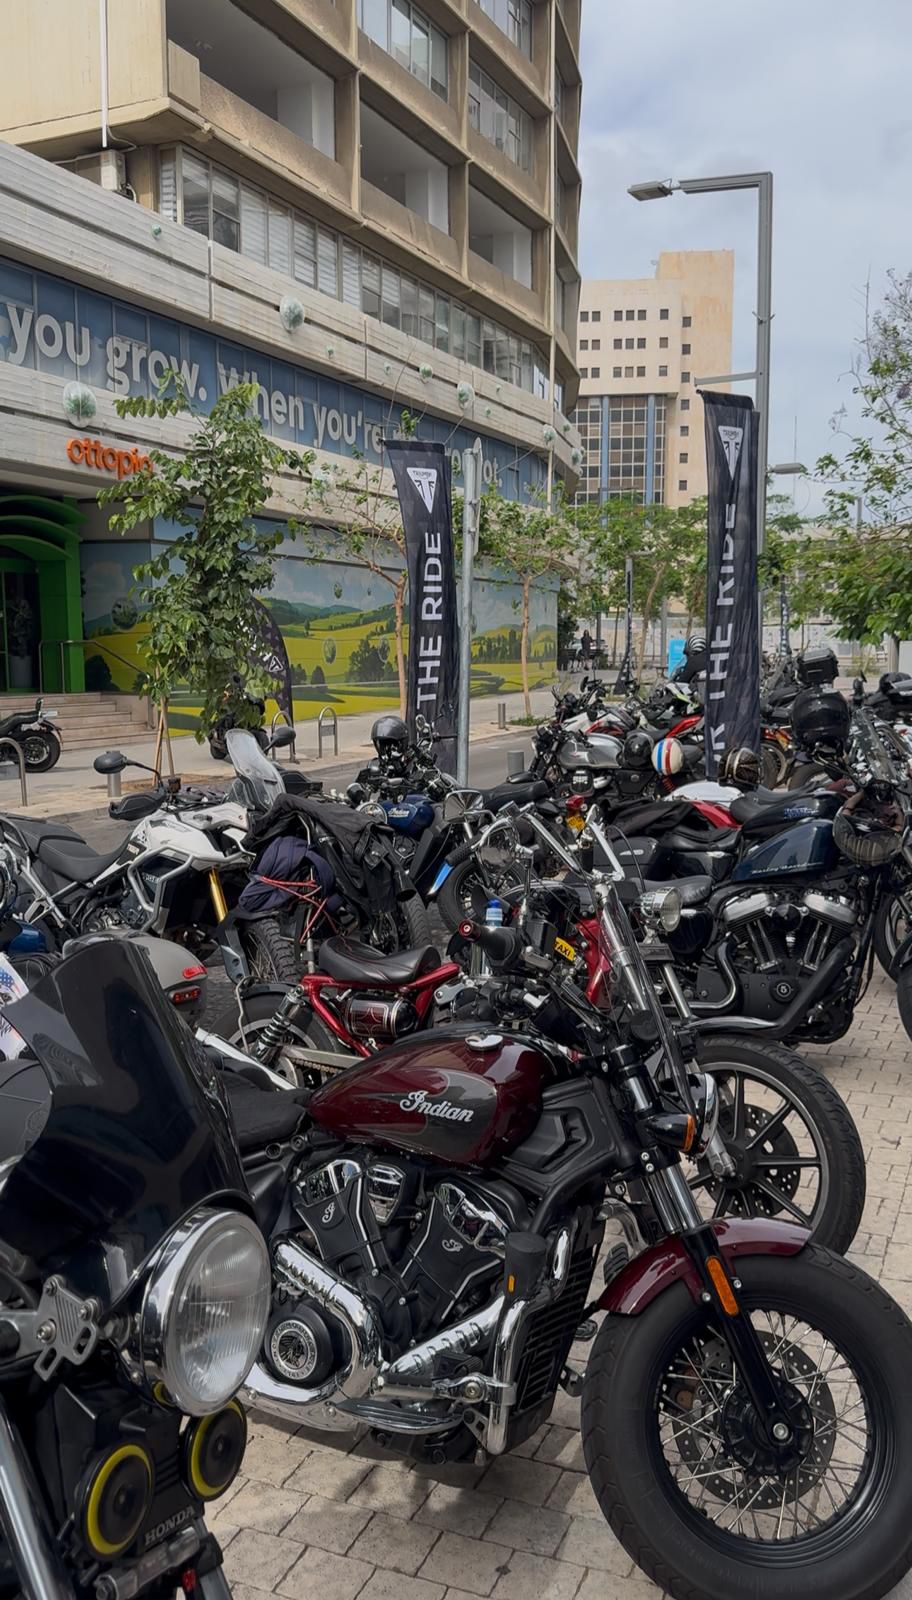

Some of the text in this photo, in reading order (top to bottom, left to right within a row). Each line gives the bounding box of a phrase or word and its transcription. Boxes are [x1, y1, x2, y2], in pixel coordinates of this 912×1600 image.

[6, 302, 91, 365] you
[106, 335, 207, 401] grow.
[312, 403, 386, 454] you're
[416, 532, 443, 709] THE RIDE
[554, 941, 572, 957] TAXI
[399, 1090, 474, 1122] Indian
[144, 1505, 195, 1546] HONDA
